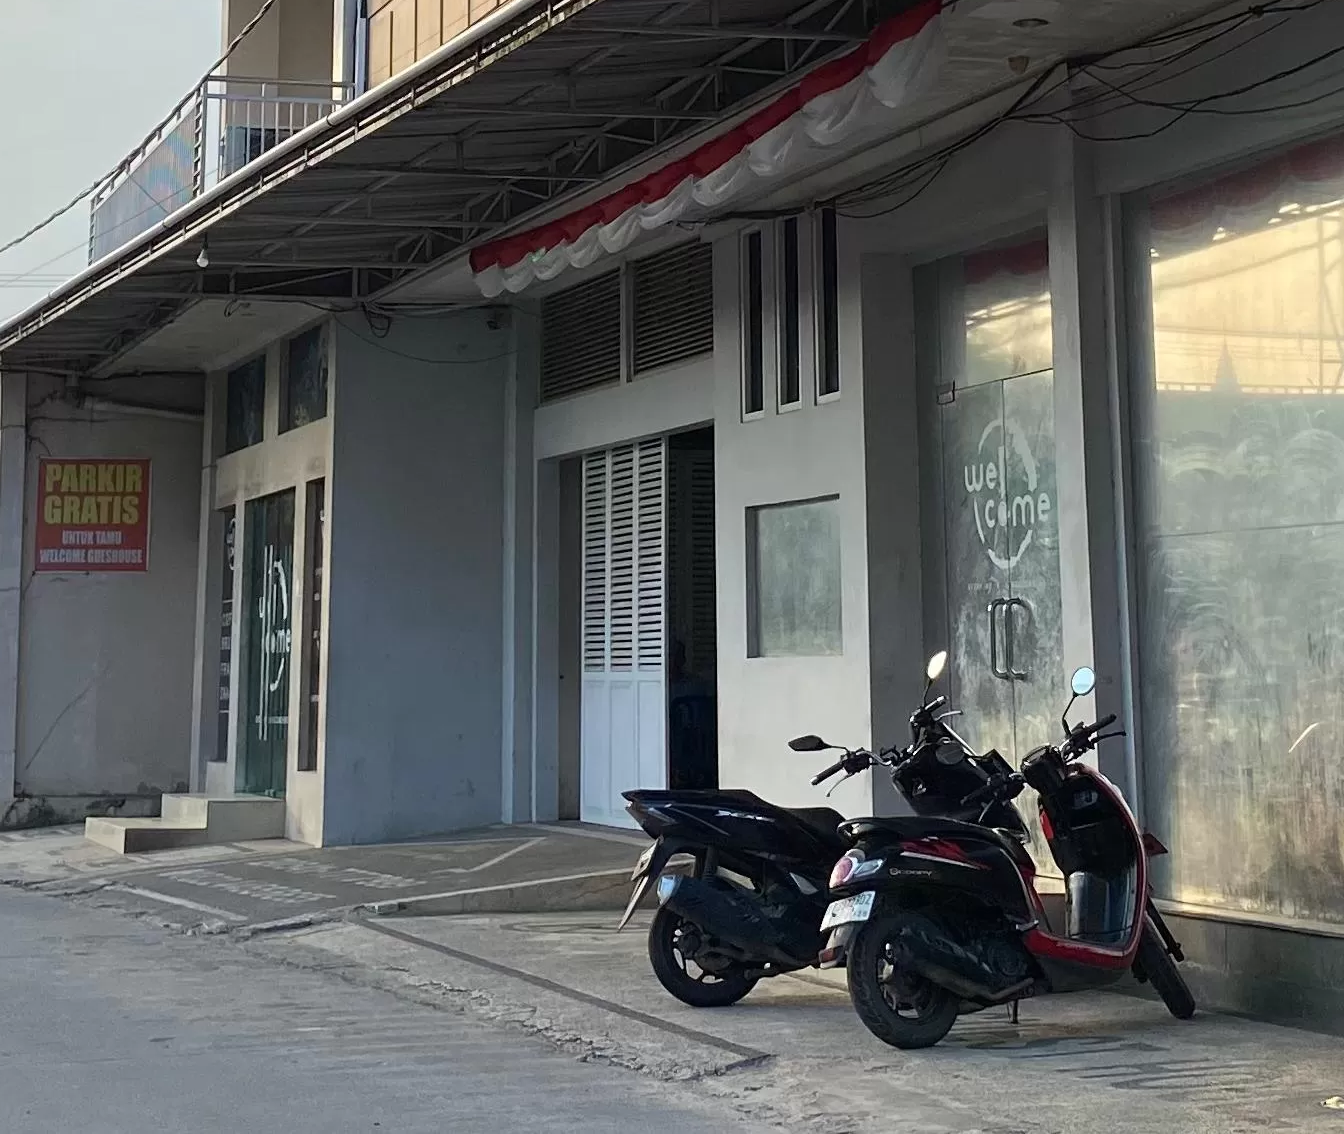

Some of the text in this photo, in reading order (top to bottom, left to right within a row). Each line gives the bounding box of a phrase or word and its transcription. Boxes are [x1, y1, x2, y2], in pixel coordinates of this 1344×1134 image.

[45, 464, 143, 492] PARKIR
[43, 495, 139, 524] GRATIS
[984, 492, 1051, 528] come
[62, 530, 122, 545] UNTUK TAMU
[40, 549, 86, 563] WELCOME
